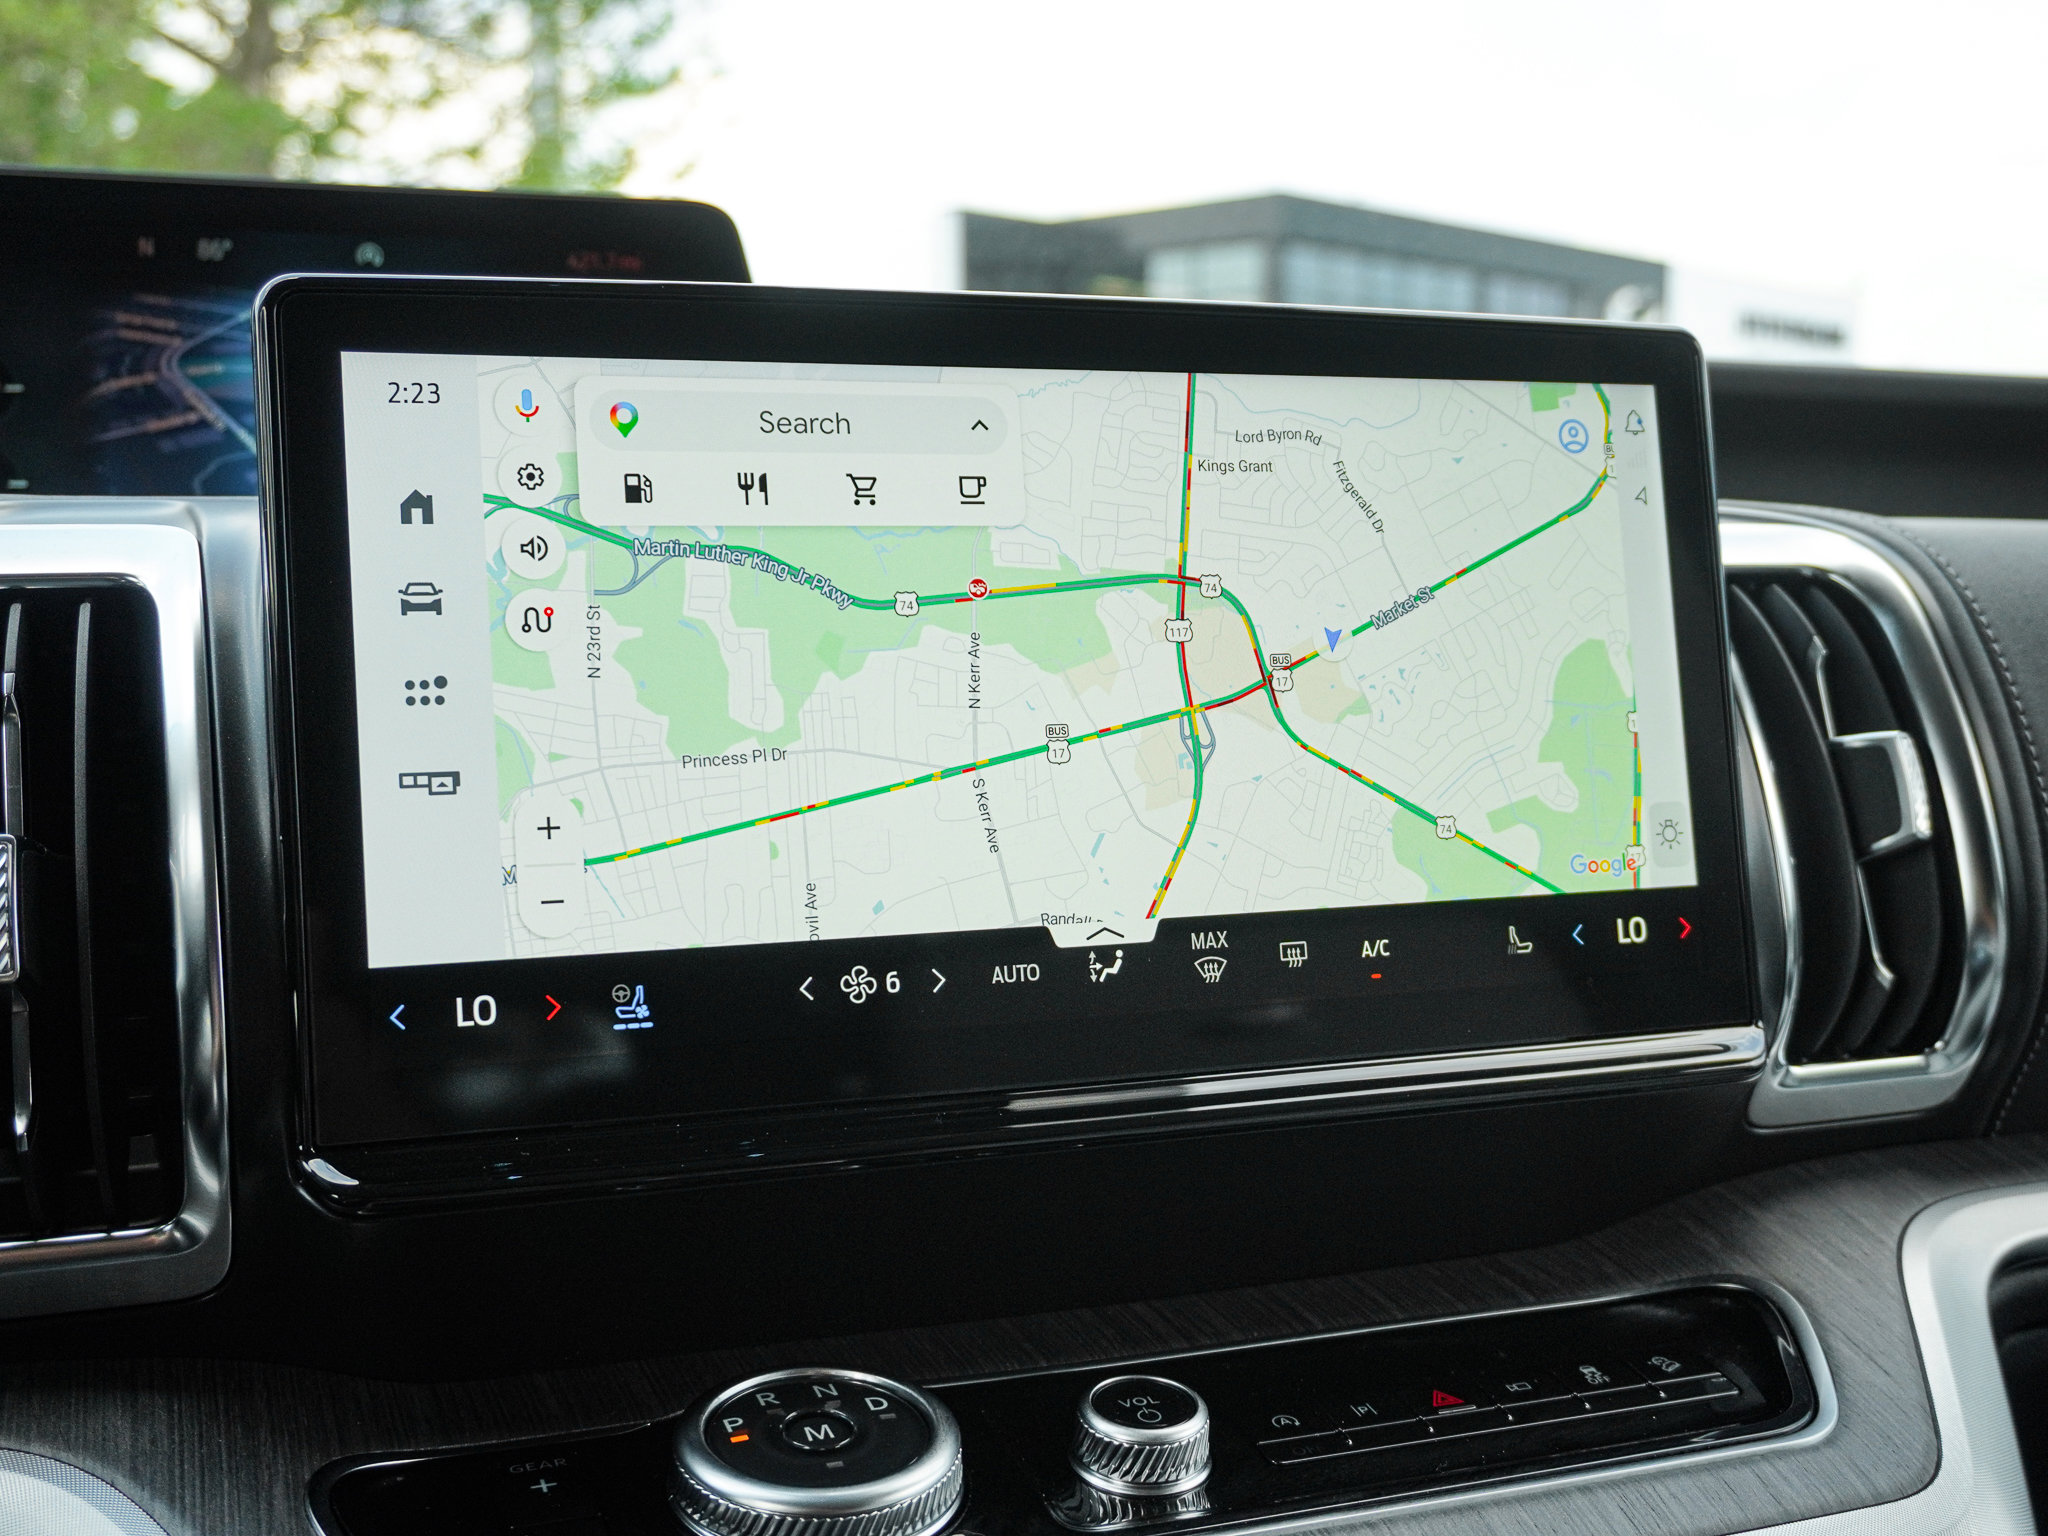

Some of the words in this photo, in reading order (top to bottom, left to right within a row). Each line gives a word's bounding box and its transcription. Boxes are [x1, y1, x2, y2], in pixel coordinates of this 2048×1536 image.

[387, 382, 440, 404] 2:23
[759, 410, 851, 435] Search
[1235, 430, 1264, 443] Lord
[1266, 429, 1302, 444] Byron
[1304, 430, 1323, 446] Rd
[1197, 459, 1235, 475] Kings
[1238, 459, 1273, 473] Grant
[1332, 460, 1378, 520] Fitzgerald
[1371, 518, 1386, 535] Dr
[632, 538, 690, 557] Martin
[694, 541, 749, 566] Luther
[751, 552, 790, 582] King
[790, 566, 811, 585] Jr
[810, 574, 855, 610] Pkwy
[1204, 583, 1218, 593] 74
[586, 604, 601, 621] St
[899, 601, 914, 611] 74
[1369, 589, 1419, 631] Market
[1416, 585, 1436, 604] St
[1169, 627, 1190, 638] 117
[586, 626, 601, 662] 23rd
[967, 632, 981, 659] Ave
[1271, 655, 1290, 666] BUS
[587, 667, 601, 679] N
[968, 664, 981, 695] Kerr
[1276, 676, 1288, 687] 17
[968, 698, 981, 709] N
[1047, 725, 1067, 737] BUS
[681, 754, 748, 769] Princess
[752, 749, 768, 763] Pl
[771, 747, 788, 761] Dr
[1052, 748, 1065, 759] 17
[972, 778, 986, 789] S
[974, 791, 992, 824] Kerr
[1439, 824, 1452, 834] 74
[983, 825, 1000, 854] Ave
[1569, 852, 1637, 878] Google
[804, 882, 818, 911] Ave
[804, 915, 820, 941] ovil
[1616, 916, 1648, 944] LO
[1190, 930, 1229, 950] MAX
[1362, 939, 1390, 959] A/C
[885, 971, 901, 994] 6
[991, 963, 1041, 985] AUTO
[455, 994, 498, 1028] LO
[756, 1392, 781, 1407] R
[812, 1383, 839, 1398] N
[864, 1396, 889, 1411] D
[1117, 1395, 1160, 1408] VOL
[722, 1417, 744, 1433] P
[803, 1423, 835, 1442] M
[509, 1458, 567, 1474] GEAR
